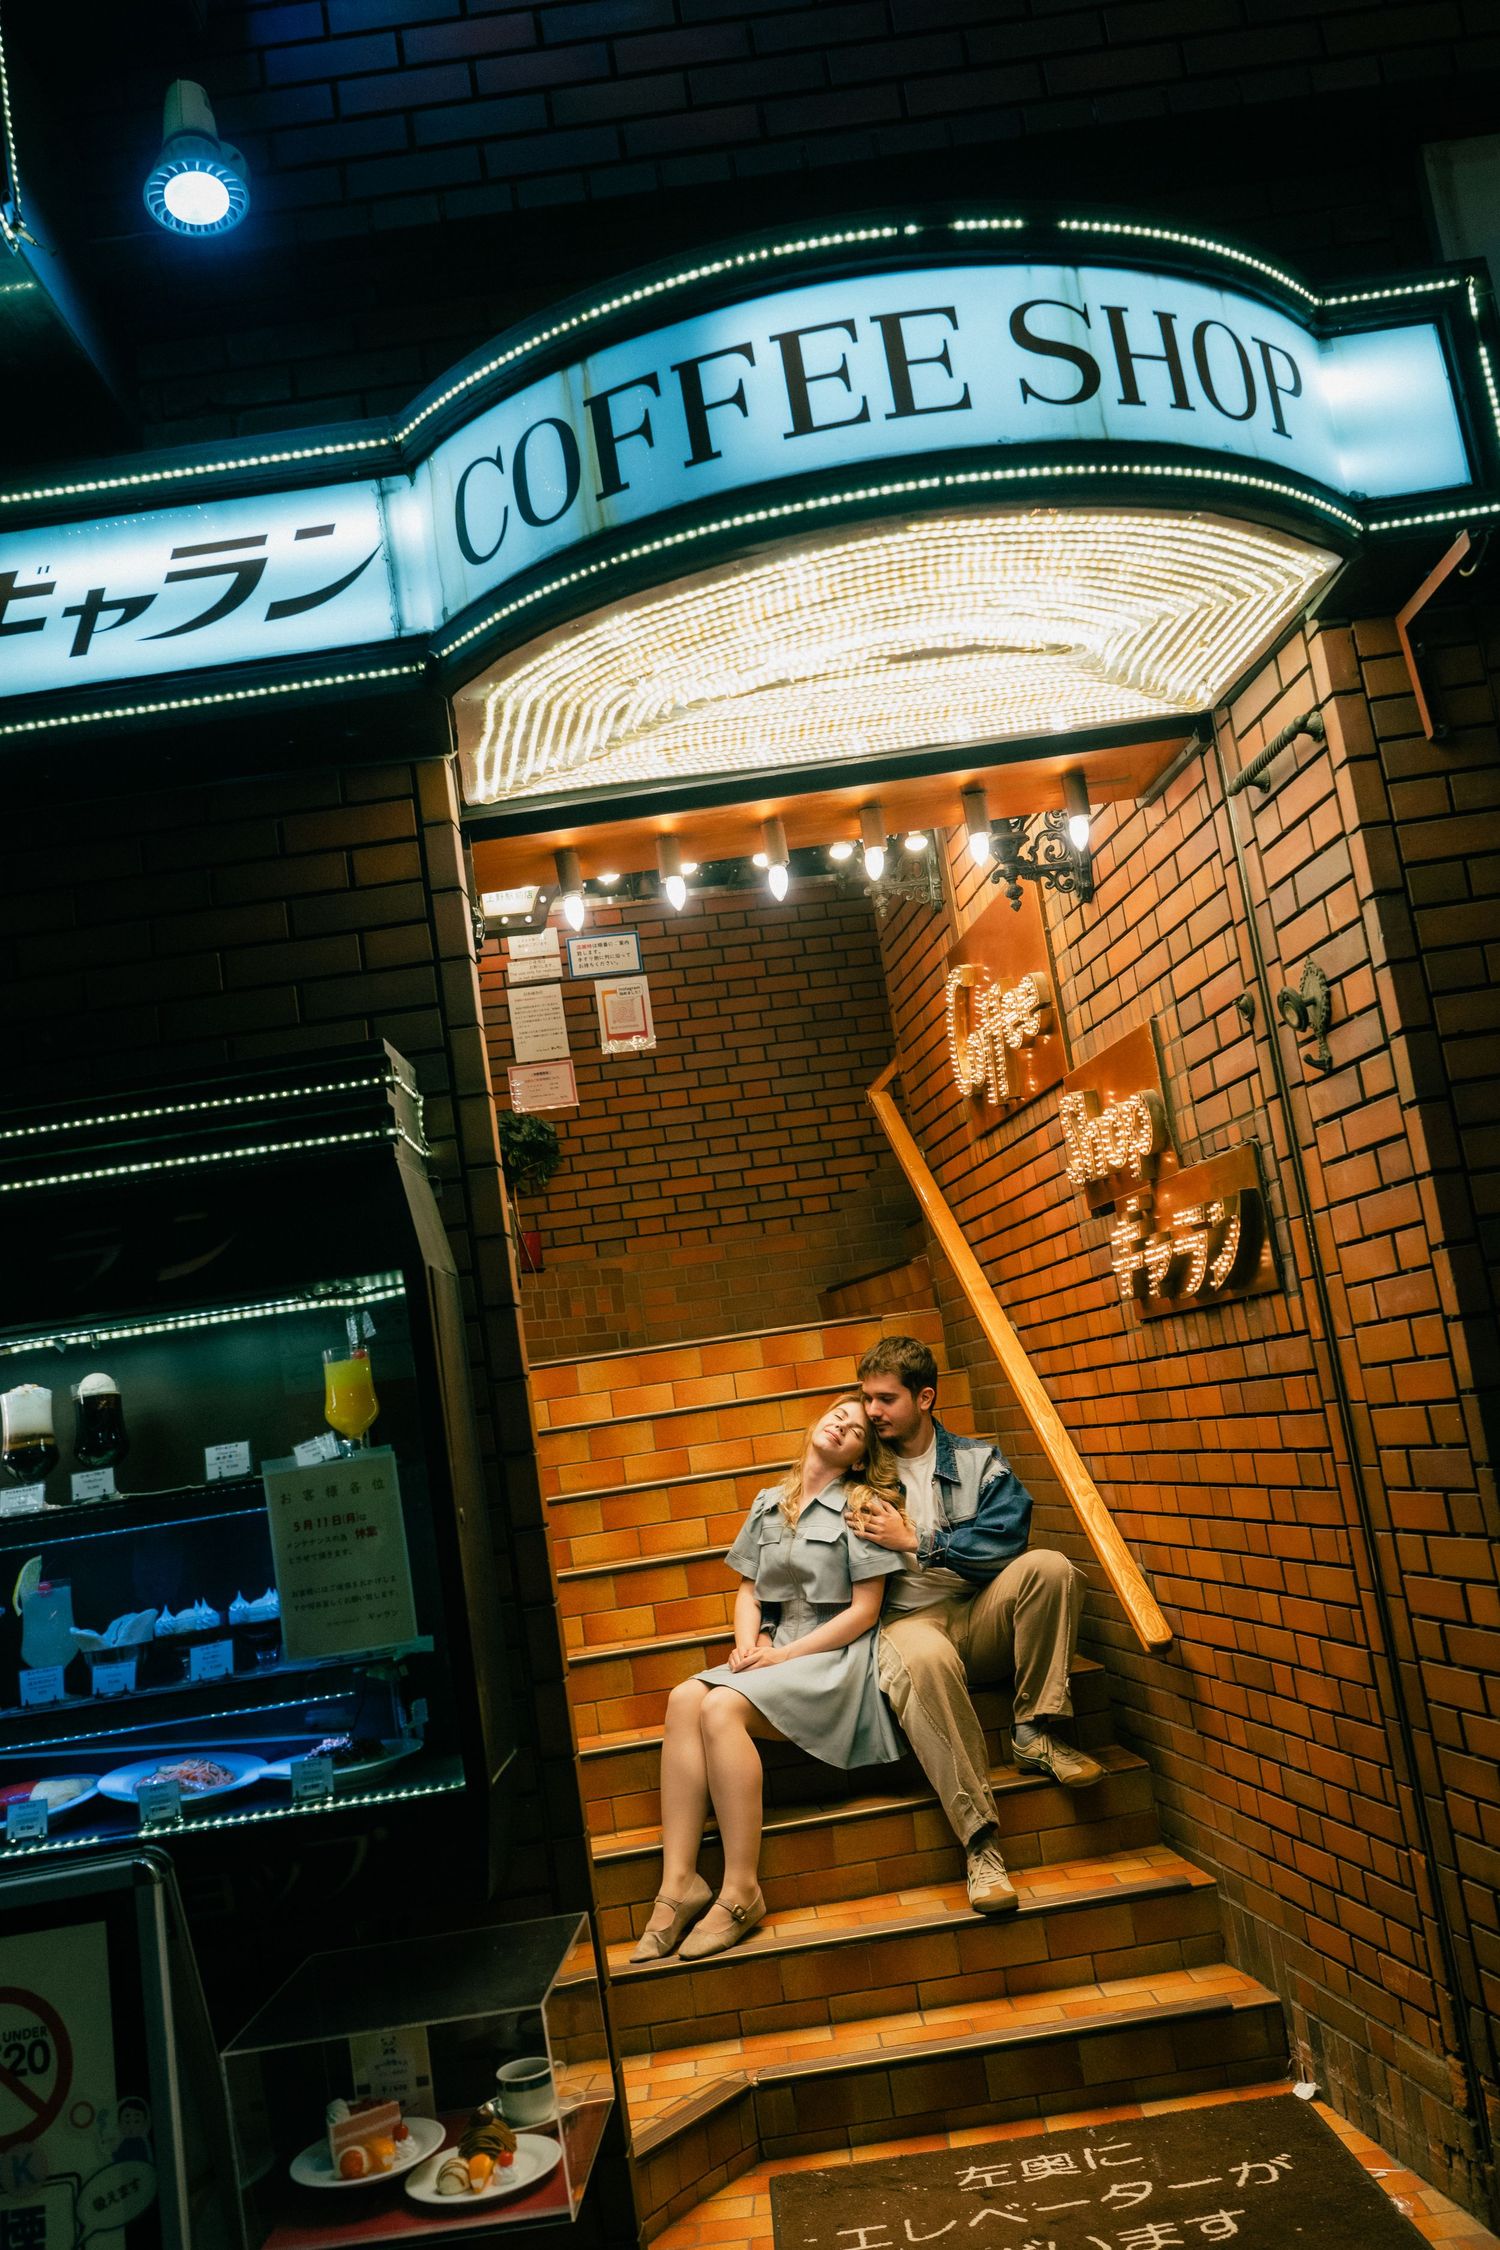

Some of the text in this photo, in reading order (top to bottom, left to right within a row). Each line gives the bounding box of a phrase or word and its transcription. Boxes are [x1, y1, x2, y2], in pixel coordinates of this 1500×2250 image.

[453, 299, 1302, 566] COFFEE SHOP
[0, 523, 382, 658] ギャラン
[280, 1478, 385, 1505] お客様各位
[2, 2026, 48, 2043] UNDER
[4, 2039, 50, 2077] 20
[954, 2142, 1145, 2192] 左奥に
[837, 2153, 1291, 2250] エレベーターが
